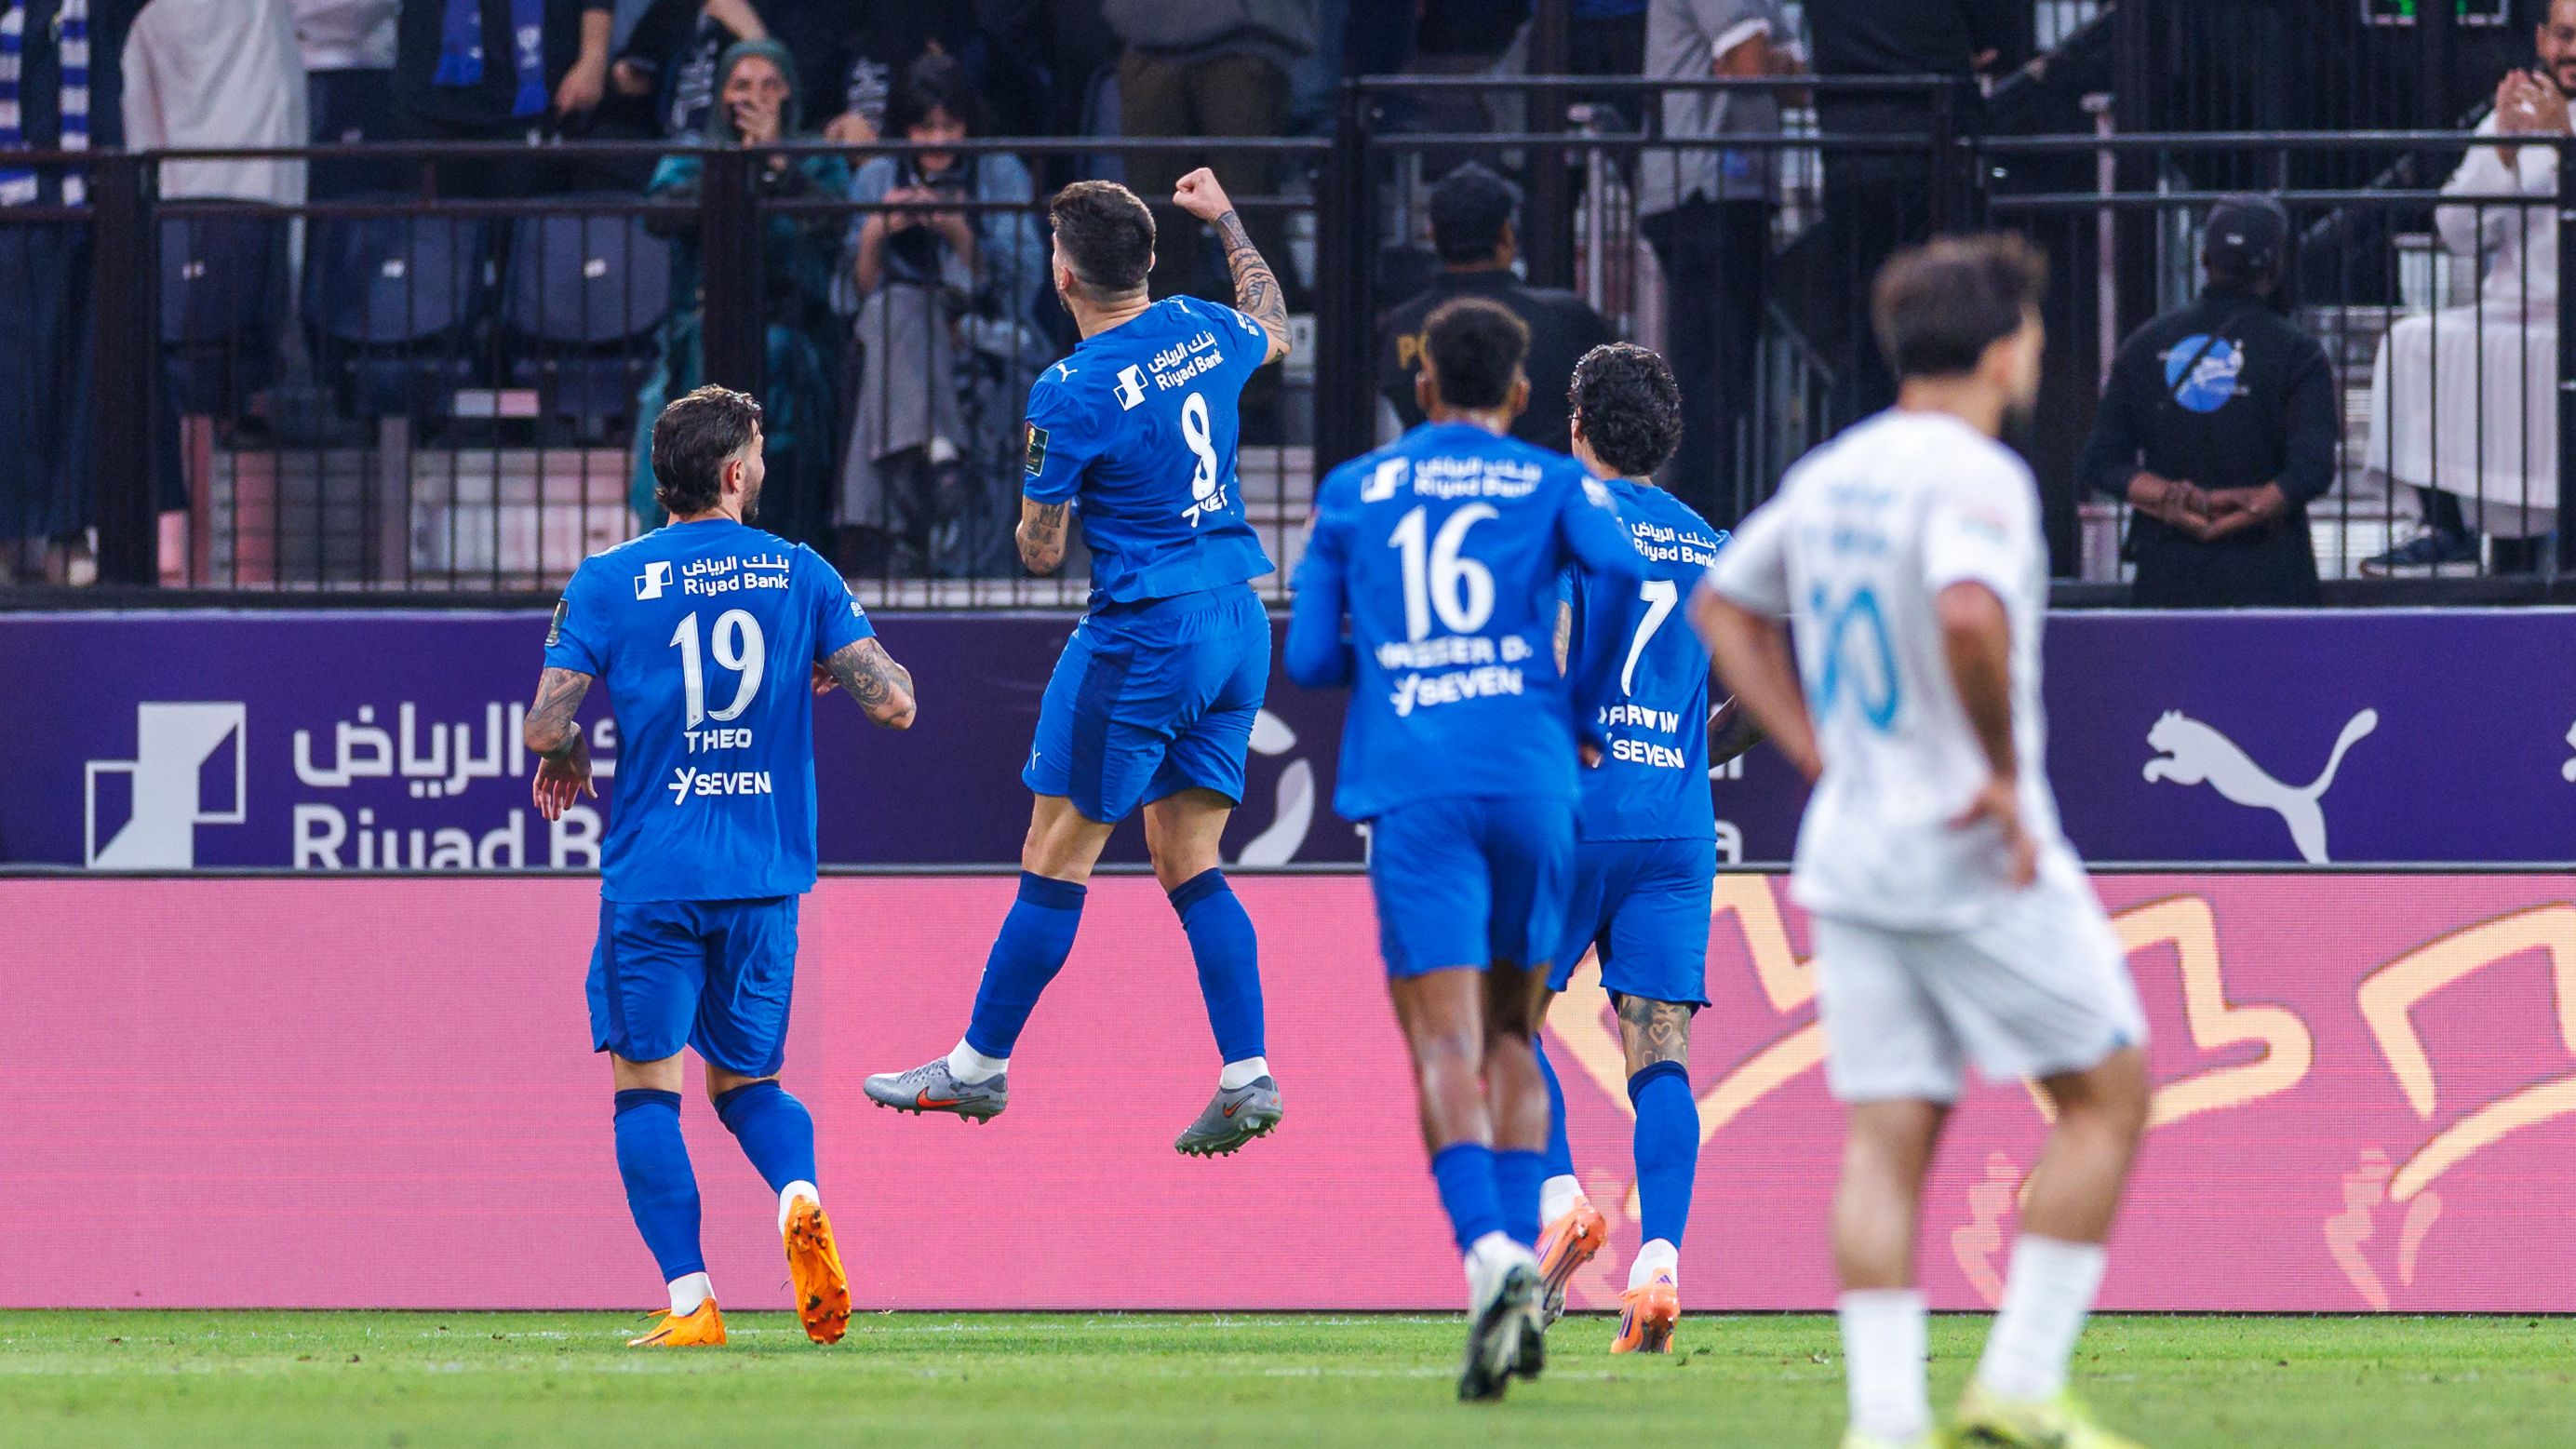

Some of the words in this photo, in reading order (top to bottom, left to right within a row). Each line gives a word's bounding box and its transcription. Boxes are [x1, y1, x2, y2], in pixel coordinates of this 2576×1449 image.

[1187, 329, 1218, 354] بنك
[1147, 342, 1188, 373] الرياض
[1154, 360, 1198, 391] Riyad
[1193, 348, 1224, 373] Bank
[1181, 392, 1218, 501] 8
[1630, 521, 1675, 543] الرياض
[1678, 531, 1717, 553] بنك
[681, 556, 738, 577] الرياض
[742, 553, 790, 573] بنك
[1633, 537, 1679, 562] Riyad
[1681, 545, 1717, 570] Bank
[683, 574, 740, 597] Riyad
[743, 572, 790, 589] Bank
[1388, 502, 1499, 642] 16
[1620, 579, 1678, 697] 7
[669, 609, 765, 731] 19
[293, 701, 525, 798] الرياض
[683, 728, 753, 754] THEO
